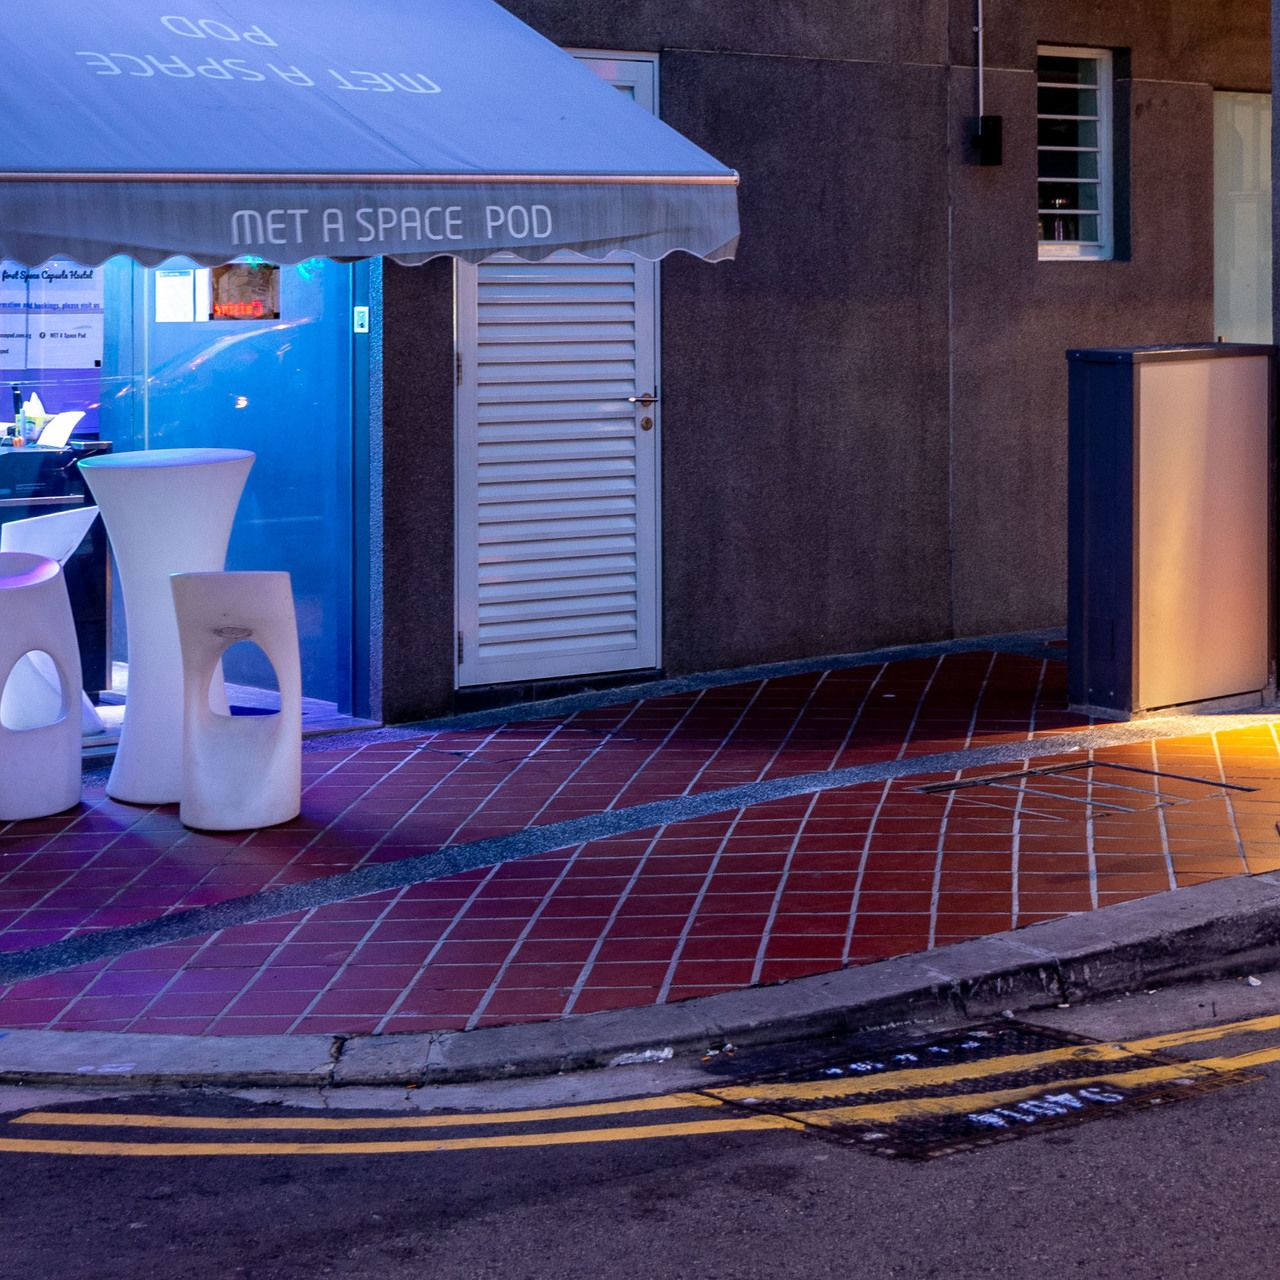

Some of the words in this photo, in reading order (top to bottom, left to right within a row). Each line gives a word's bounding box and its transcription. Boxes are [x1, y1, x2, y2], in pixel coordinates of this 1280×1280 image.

[160, 15, 279, 47] POD
[75, 51, 267, 82] SPACE
[328, 68, 443, 94] MET
[231, 209, 309, 245] MET
[323, 208, 344, 243] A
[356, 206, 463, 242] SPACE
[486, 204, 553, 239] POD
[69, 269, 94, 280] Hostel
